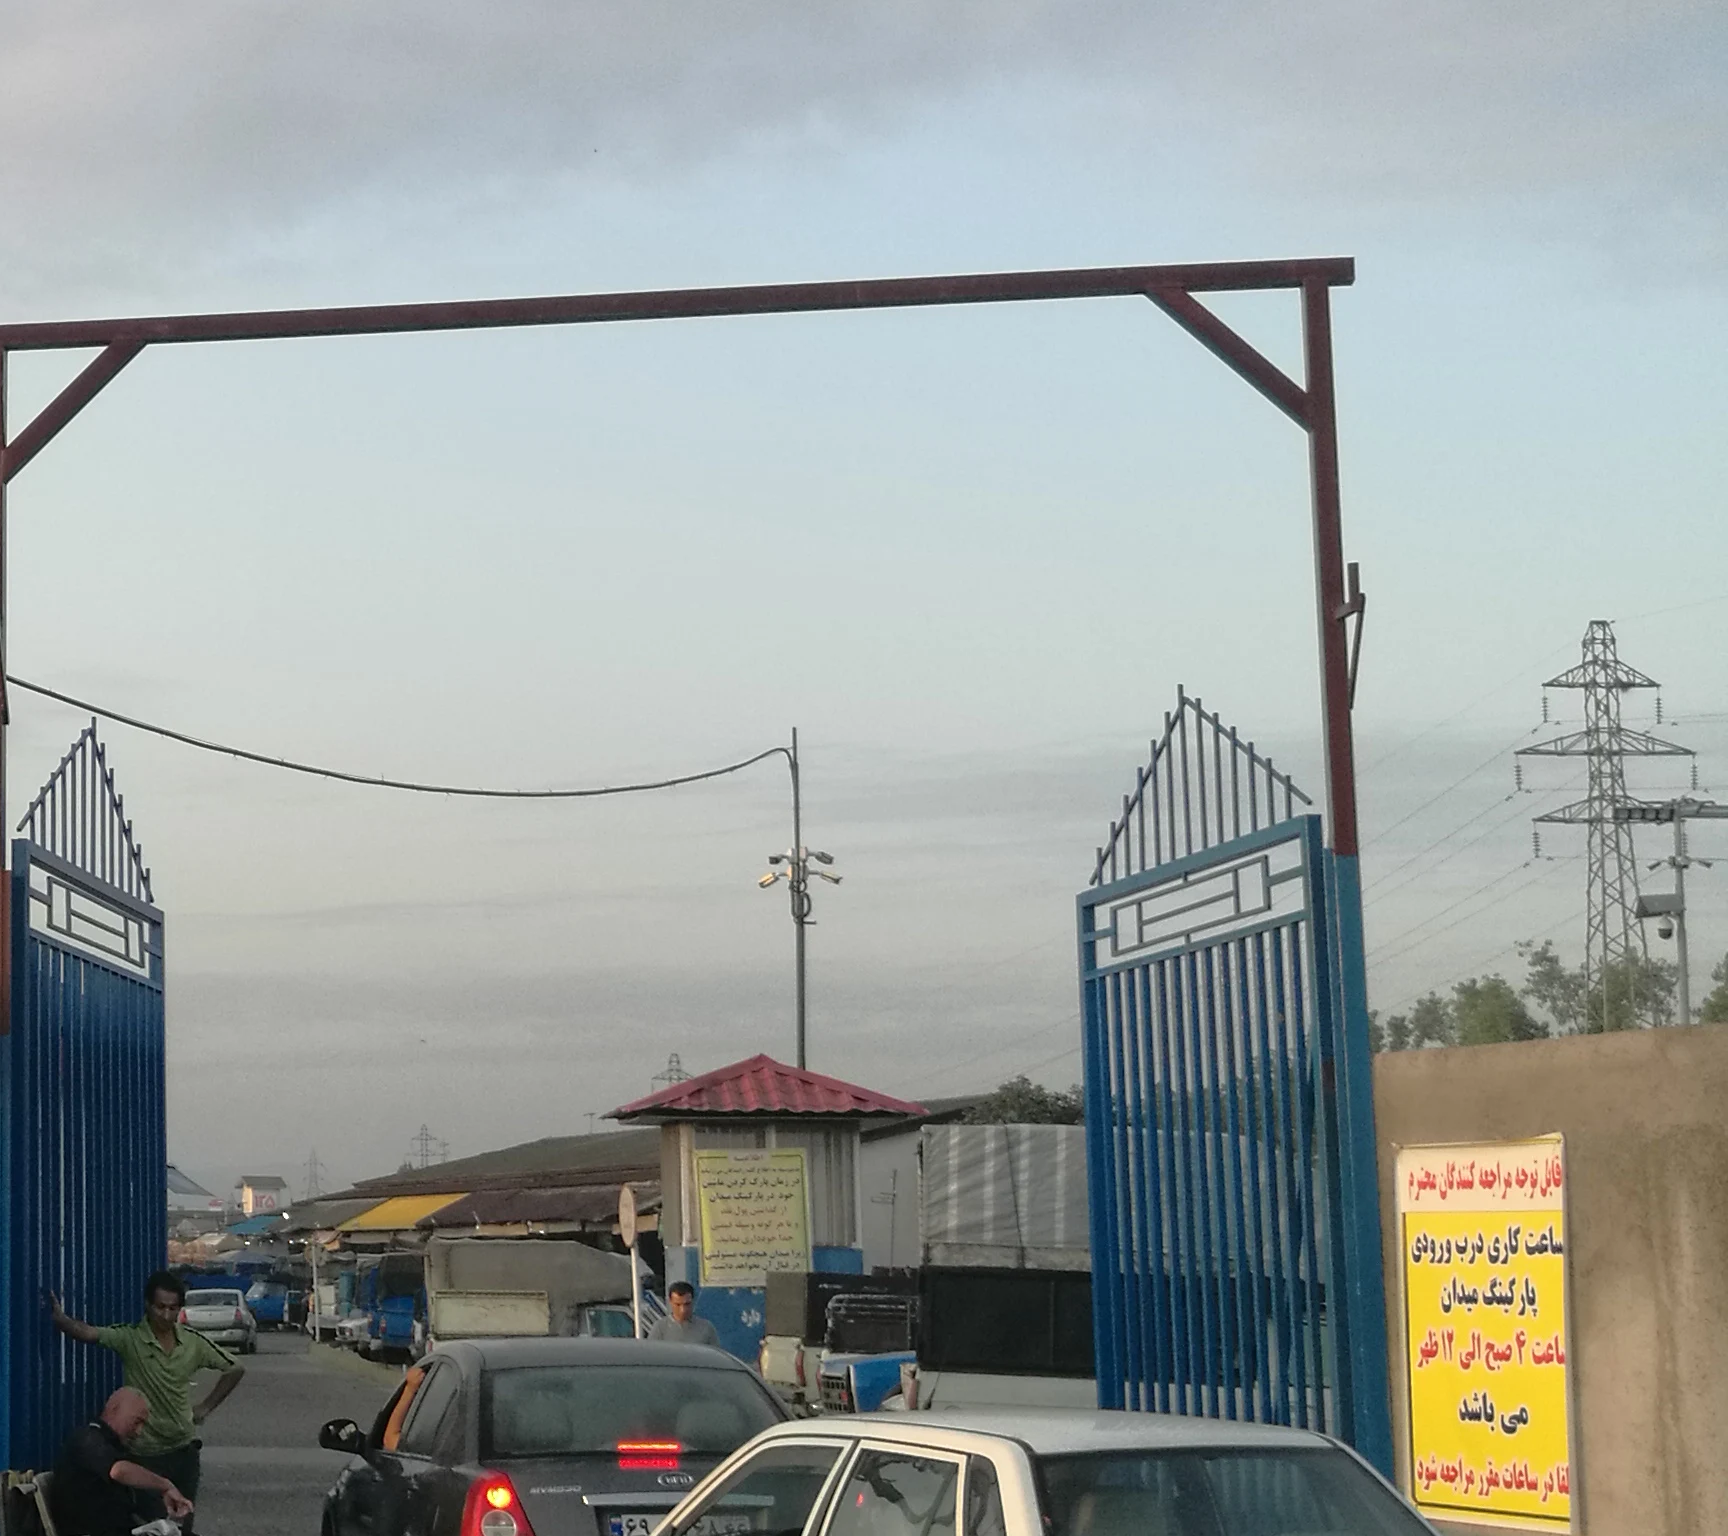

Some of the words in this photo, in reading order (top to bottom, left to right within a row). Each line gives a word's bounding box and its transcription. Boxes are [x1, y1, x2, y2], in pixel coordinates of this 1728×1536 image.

[1409, 1167, 1436, 1201] محترم
[1439, 1160, 1475, 1200] کنندگان
[1479, 1160, 1512, 1199] مراجعه
[1515, 1159, 1538, 1199] توجه
[1540, 1155, 1562, 1197] قابل
[1412, 1232, 1451, 1264] ورودی
[1455, 1233, 1483, 1264] درب
[1488, 1226, 1520, 1264] کاری
[1525, 1226, 1563, 1255] ساعت
[1441, 1277, 1479, 1313] میدان
[1417, 1329, 1439, 1368] ظهر
[1460, 1332, 1481, 1370] الی
[1485, 1341, 1512, 1370] صبح
[1459, 1392, 1495, 1432] باشد
[1500, 1407, 1528, 1434] می
[1417, 1456, 1437, 1491] شود
[1440, 1458, 1475, 1495] مراجعه
[1478, 1461, 1500, 1497] مقرر
[1502, 1462, 1538, 1491] ساعات
[1542, 1471, 1554, 1502] در
